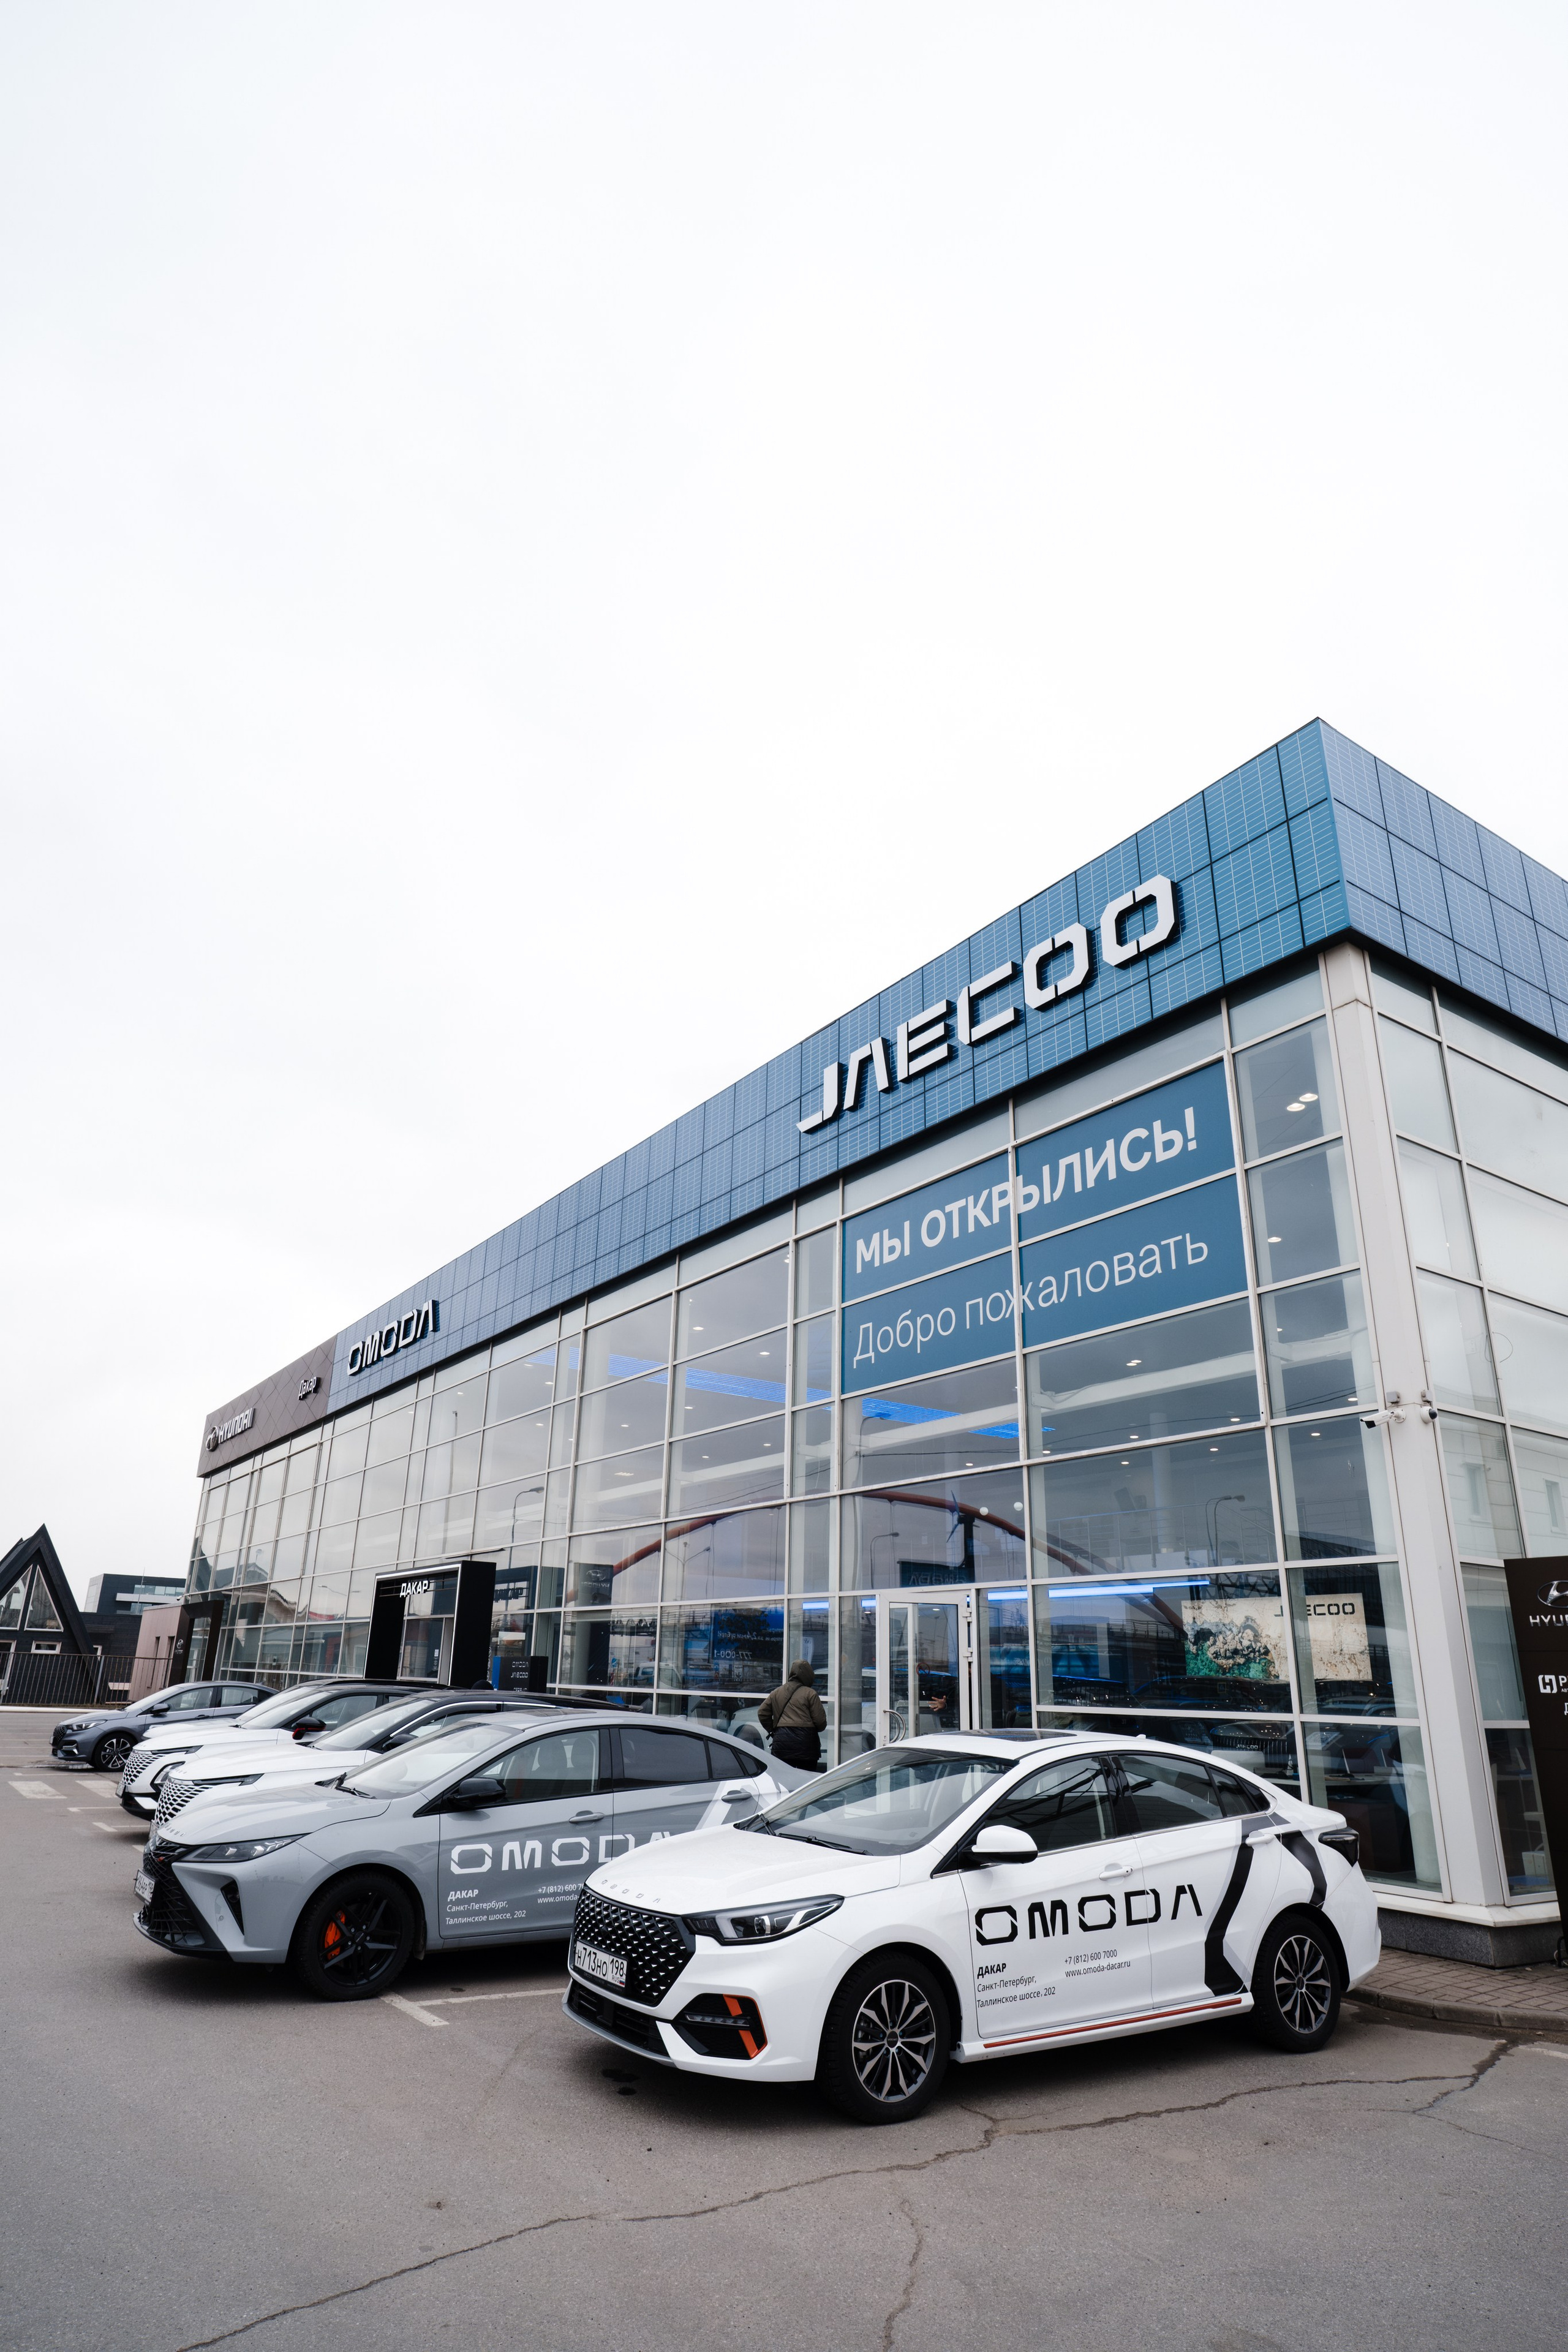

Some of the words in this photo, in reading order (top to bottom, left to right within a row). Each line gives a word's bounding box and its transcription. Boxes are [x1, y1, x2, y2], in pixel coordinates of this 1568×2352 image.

[796, 874, 1177, 1133] JAECOO
[856, 1220, 910, 1274] МЫ
[921, 1107, 1197, 1247] ОТКРЫЛИСЬ!
[853, 1307, 956, 1368] Добро
[966, 1232, 1208, 1329] пожаловать
[347, 1299, 434, 1376] OMODA
[298, 1376, 317, 1400] Дакар
[218, 1408, 254, 1444] HYUNDAI
[400, 1580, 428, 1597] ДАКАР
[447, 1889, 479, 1902] ДАКАР
[547, 1885, 564, 1894] (812)
[447, 1901, 508, 1912] Санкт-Петербург,
[974, 1883, 1203, 1946] OMODA
[445, 1915, 488, 1925] Таллинское
[489, 1912, 512, 1921] шоссе,
[514, 1910, 526, 1918] 202
[1065, 1956, 1072, 1965] +7
[1074, 1953, 1089, 1965] (812)
[1090, 1951, 1101, 1961] 600
[1102, 1949, 1117, 1959] 7000
[610, 1958, 624, 1977] 198
[977, 1962, 1006, 1979] ДАКАР
[1065, 1960, 1131, 1978] www.omoda-dacar.ru
[611, 1975, 620, 1983] RUS
[977, 1975, 1037, 1992] Санкт-Петербург,
[977, 1993, 1017, 2008] Таллинское
[1019, 1990, 1042, 2002] шоссе,
[1044, 1986, 1056, 1997] 202
